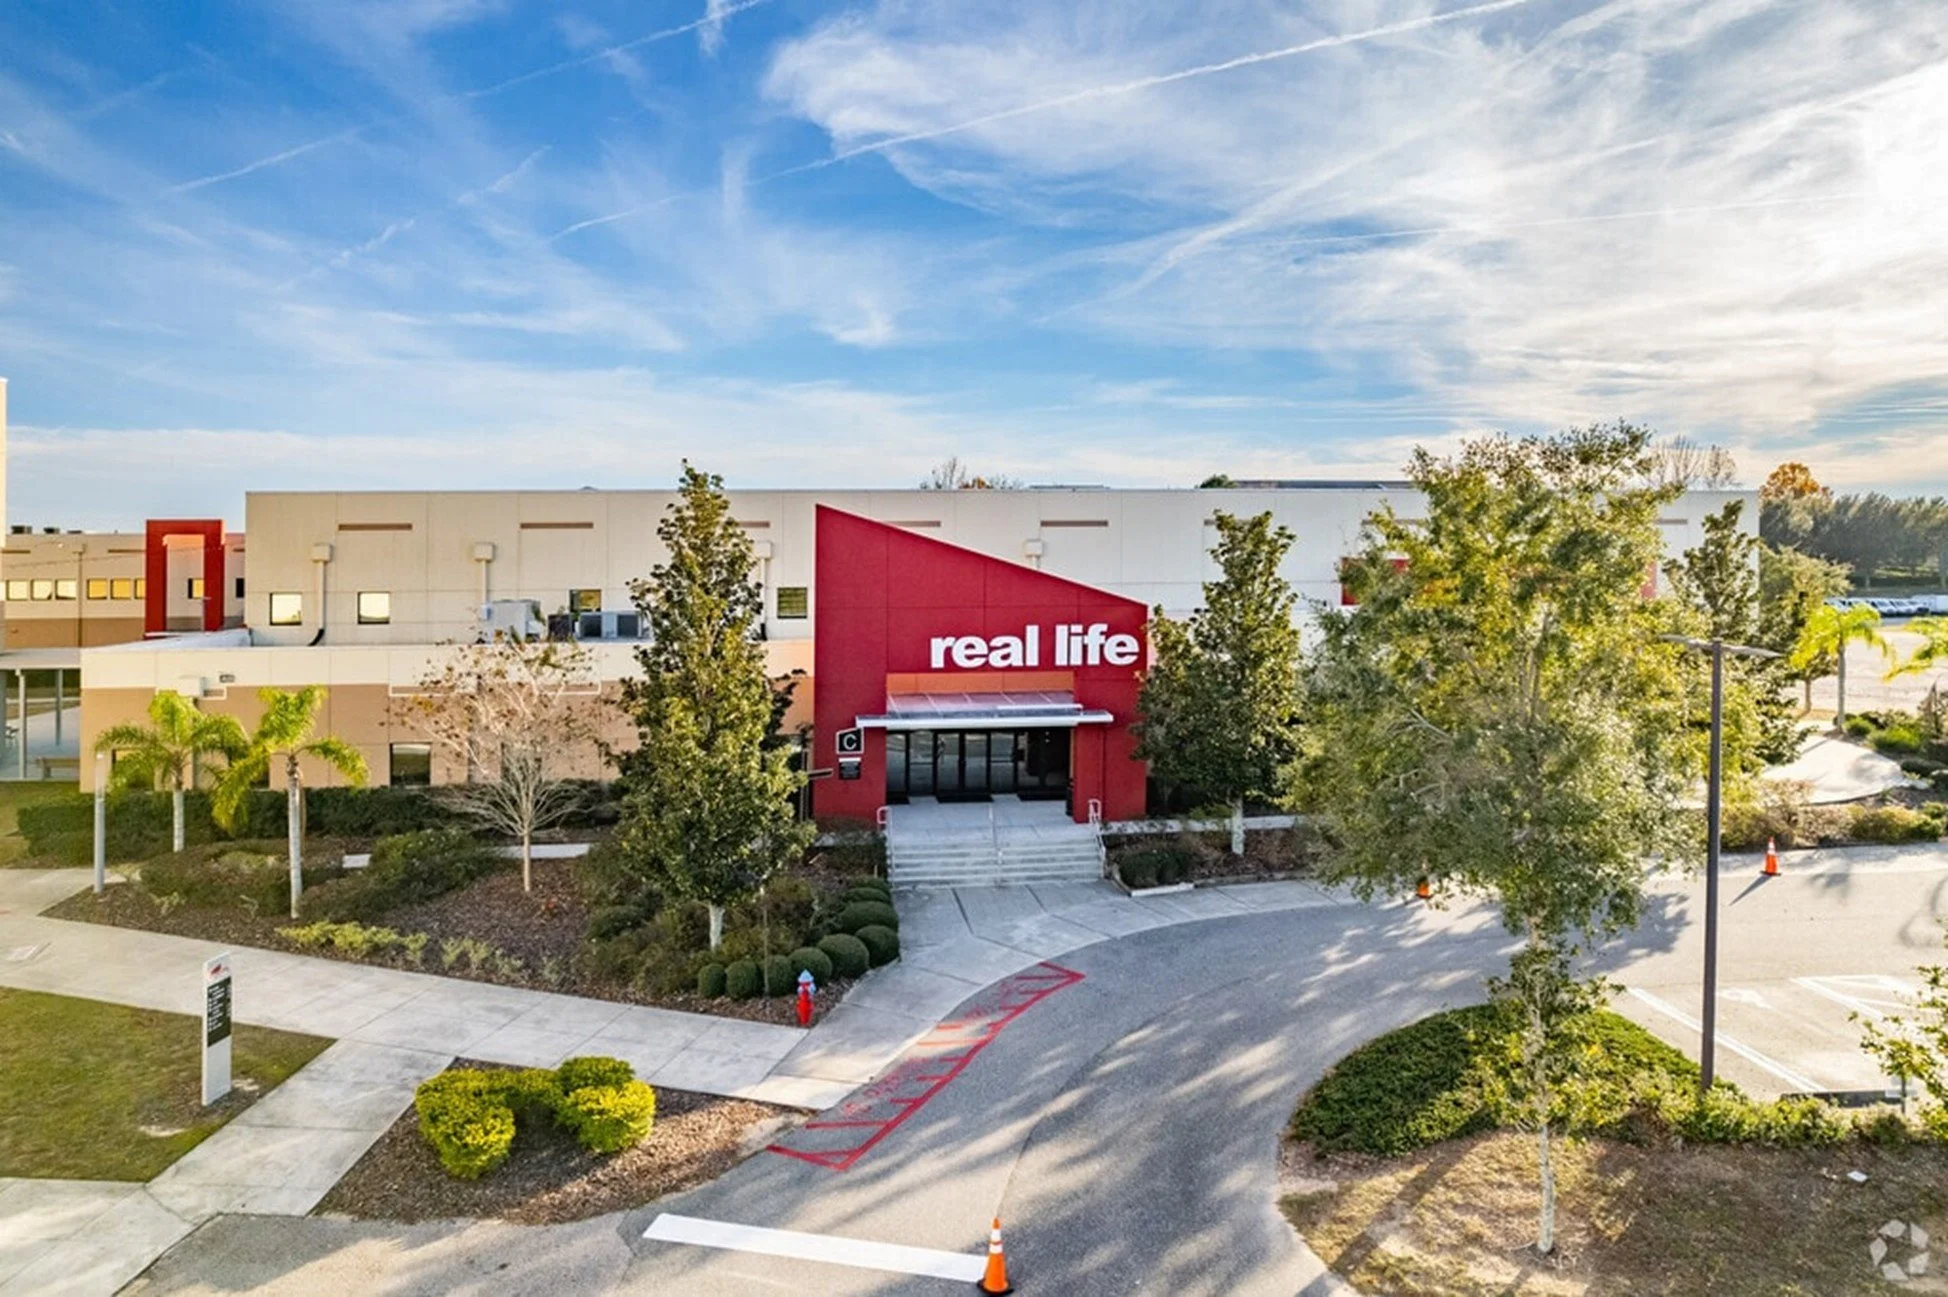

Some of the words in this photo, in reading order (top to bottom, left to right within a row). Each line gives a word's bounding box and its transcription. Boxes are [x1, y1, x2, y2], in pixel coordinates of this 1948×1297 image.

[930, 624, 1039, 669] real
[1055, 623, 1139, 666] life
[843, 733, 857, 750] C
